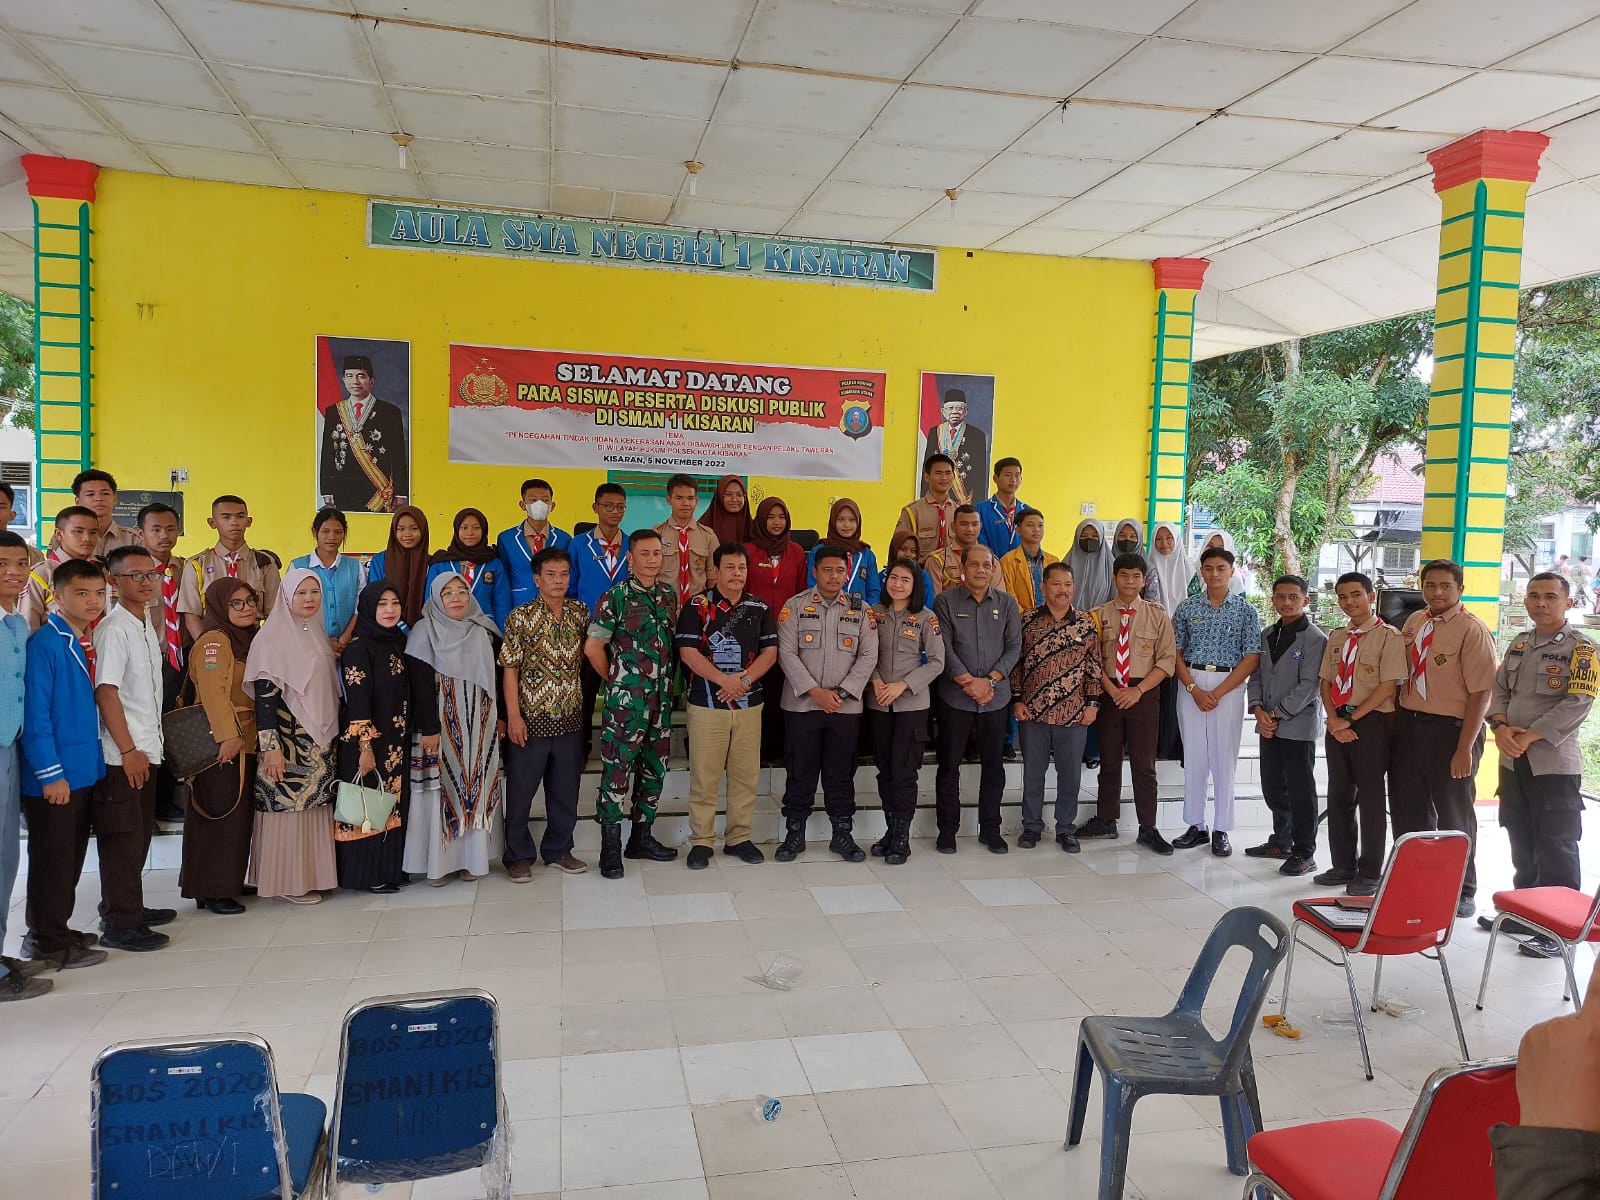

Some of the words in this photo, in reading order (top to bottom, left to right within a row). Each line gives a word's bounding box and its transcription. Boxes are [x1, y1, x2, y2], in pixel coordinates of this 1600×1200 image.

[390, 209, 491, 247] AULA
[502, 218, 580, 255] SMA
[590, 227, 724, 268] NEGERI
[735, 240, 750, 269] 1
[763, 242, 911, 283] KISARAN
[556, 362, 682, 388] SELAMAT
[687, 370, 791, 395] DATANG
[517, 384, 562, 403] PARA
[567, 387, 620, 406] SISWA
[624, 389, 697, 411] PESERTA
[701, 395, 764, 415] DISKUSI
[769, 399, 825, 418] PUBLIK
[596, 408, 614, 426] DI
[617, 410, 665, 428] SMAN
[669, 412, 679, 428] 1
[683, 413, 755, 433] KISARAN
[621, 437, 664, 446] KEKERASAN
[688, 441, 719, 449] DIBAWAH
[722, 442, 741, 450] UMUR
[802, 446, 834, 454] TAWURAN
[603, 455, 646, 464] KISARAN,
[655, 457, 703, 466] NOVEMBER
[705, 460, 726, 468] 2022
[902, 621, 921, 629] POLRI
[183, 1071, 265, 1098] 2020
